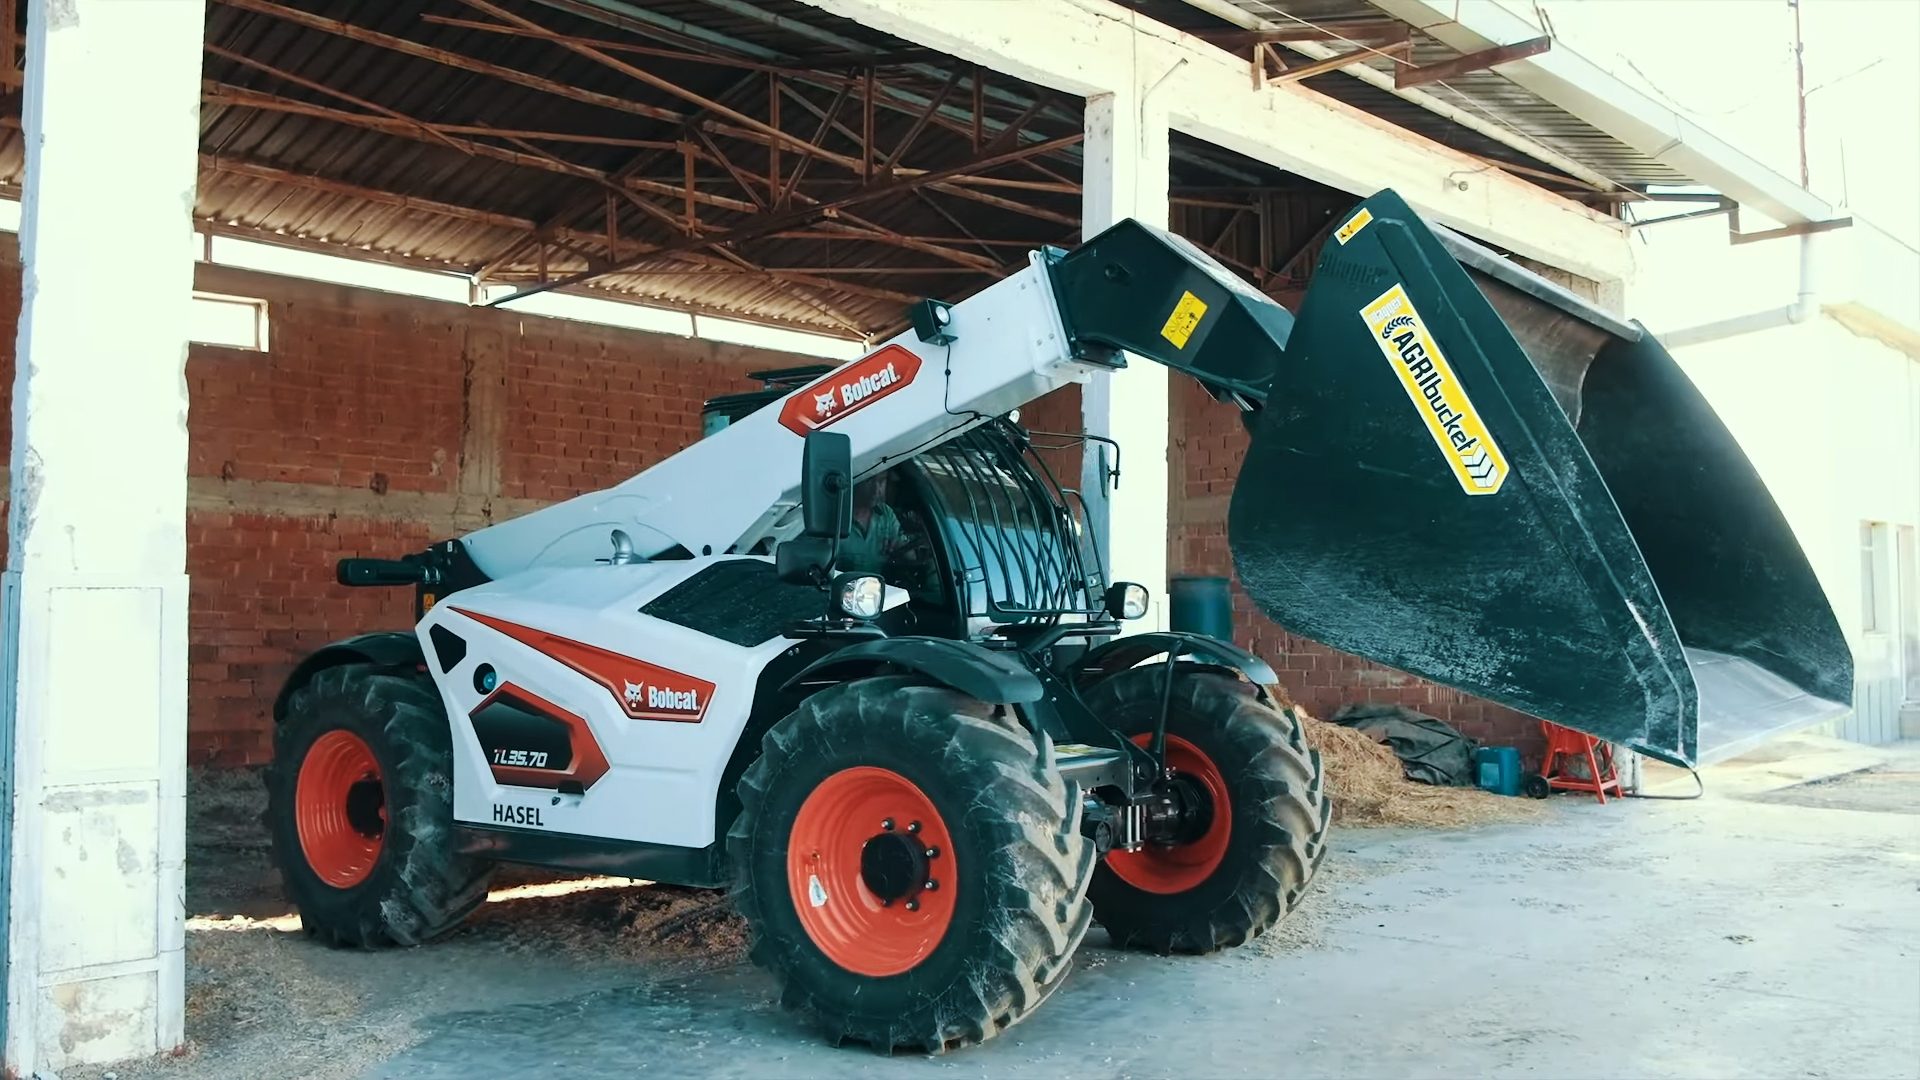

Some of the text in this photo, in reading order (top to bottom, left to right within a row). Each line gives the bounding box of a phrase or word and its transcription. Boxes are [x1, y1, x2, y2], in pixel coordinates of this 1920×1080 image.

[841, 362, 898, 407] Bobcat
[1392, 331, 1477, 453] AGRIbucket
[648, 685, 698, 710] Bobcat
[493, 803, 544, 827] HASEL
